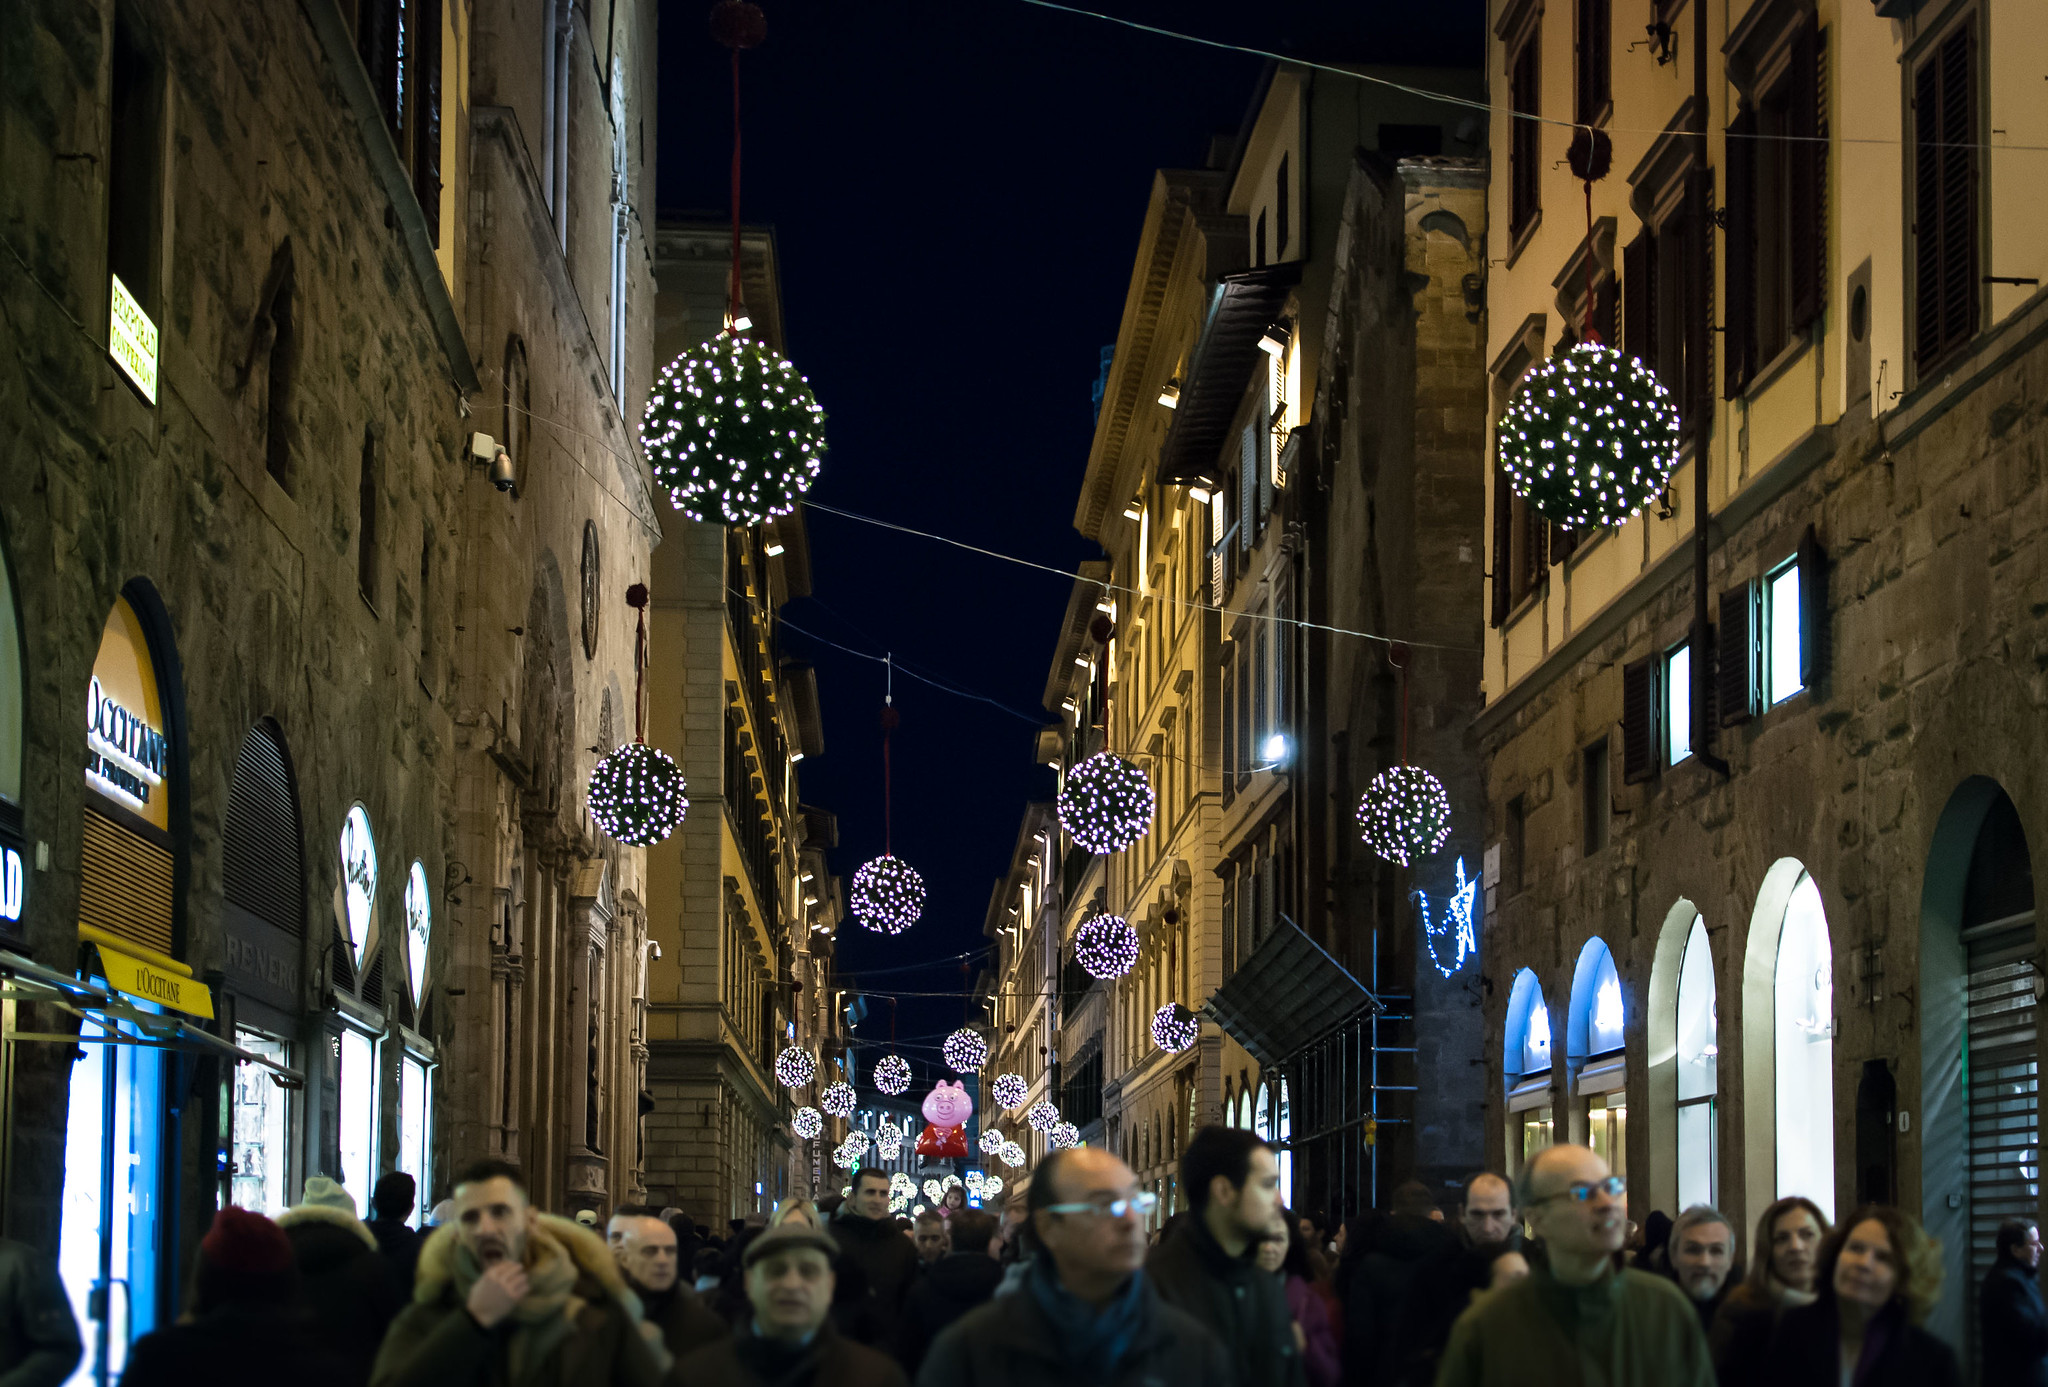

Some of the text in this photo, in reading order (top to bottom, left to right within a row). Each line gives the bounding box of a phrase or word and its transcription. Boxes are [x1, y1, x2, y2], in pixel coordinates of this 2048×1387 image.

[113, 285, 156, 359] BEMPORAD
[111, 325, 155, 393] CONFEZIONI
[136, 966, 181, 1004] L'OCCITANE
